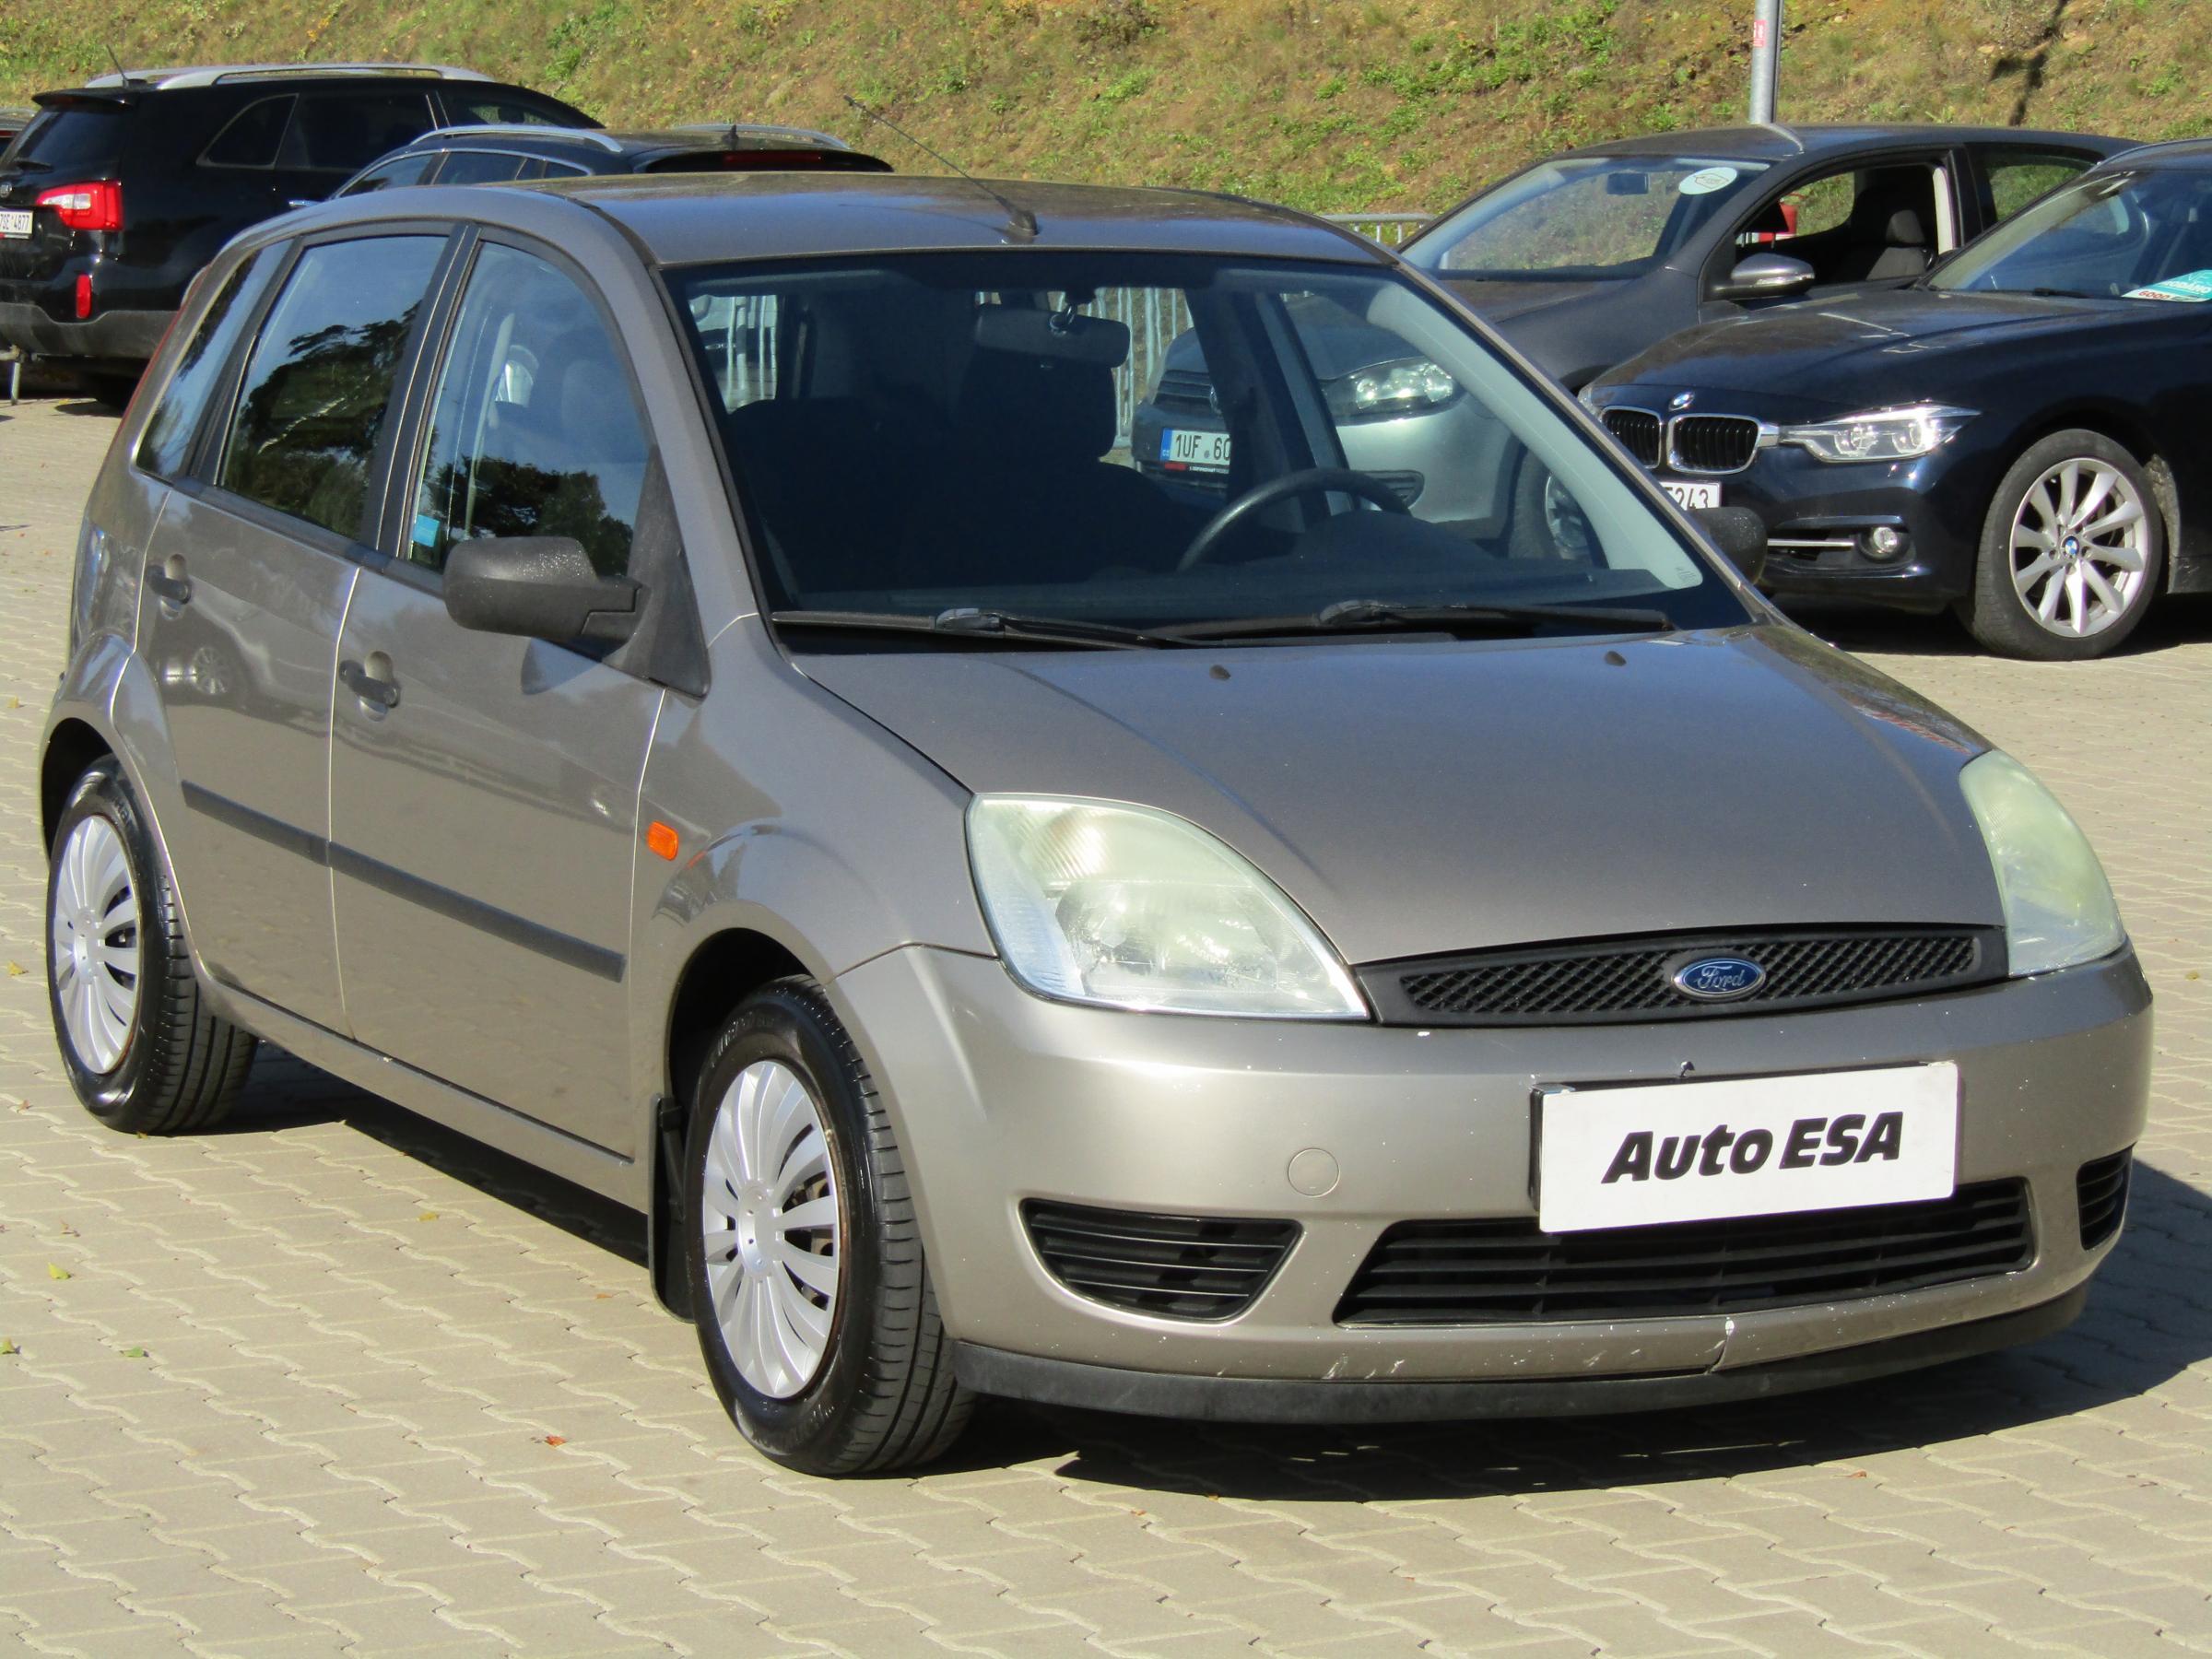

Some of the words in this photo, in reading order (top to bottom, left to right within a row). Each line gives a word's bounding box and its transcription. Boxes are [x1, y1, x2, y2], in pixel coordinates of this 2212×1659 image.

[1175, 434, 1202, 459] 1UF
[1665, 487, 1708, 509] 243
[1696, 965, 1746, 991] Ford
[1601, 1124, 1774, 1184] Auto
[1779, 1111, 1904, 1171] ESA
